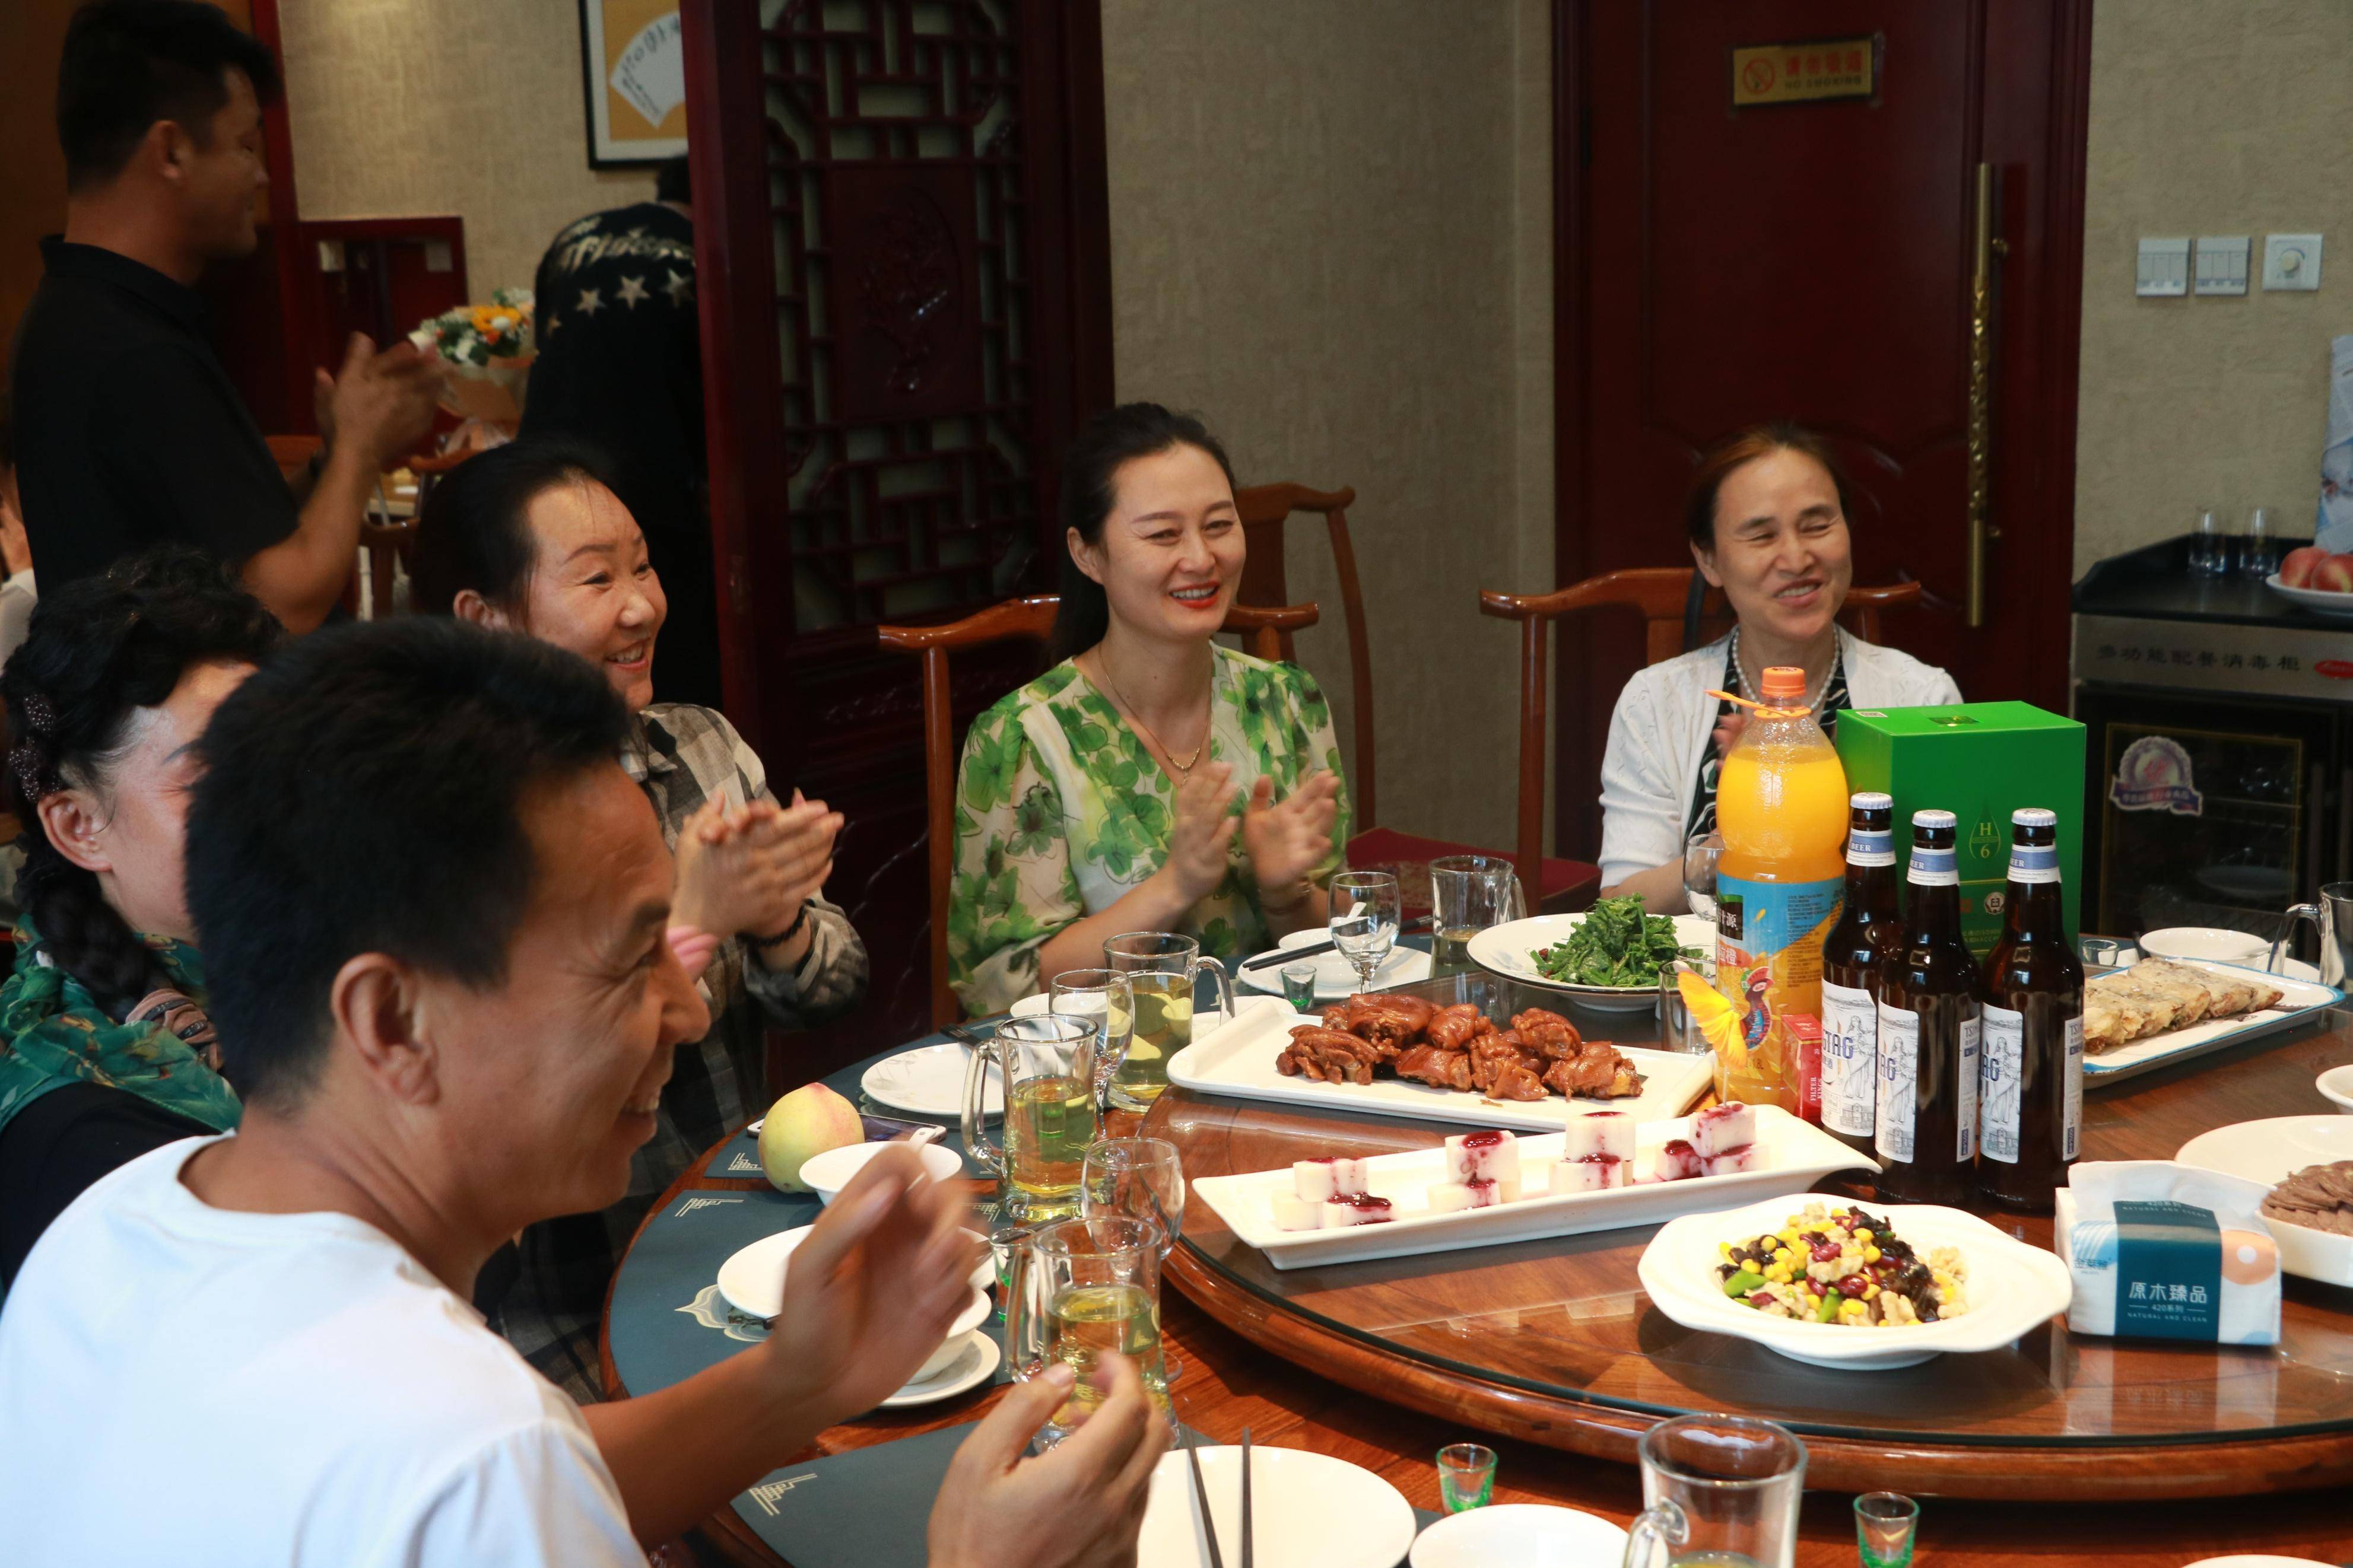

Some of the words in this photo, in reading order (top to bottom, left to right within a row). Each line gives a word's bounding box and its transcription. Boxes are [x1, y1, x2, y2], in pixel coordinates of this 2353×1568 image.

[1979, 822, 1992, 836] H
[1851, 842, 1871, 852] BEER
[1980, 844, 1990, 858] 6
[2128, 1281, 2208, 1304] 原木臻品
[2151, 1304, 2184, 1313] 420系列
[2127, 1312, 2161, 1320] NATURAL
[2183, 1315, 2208, 1324] CLEAN
